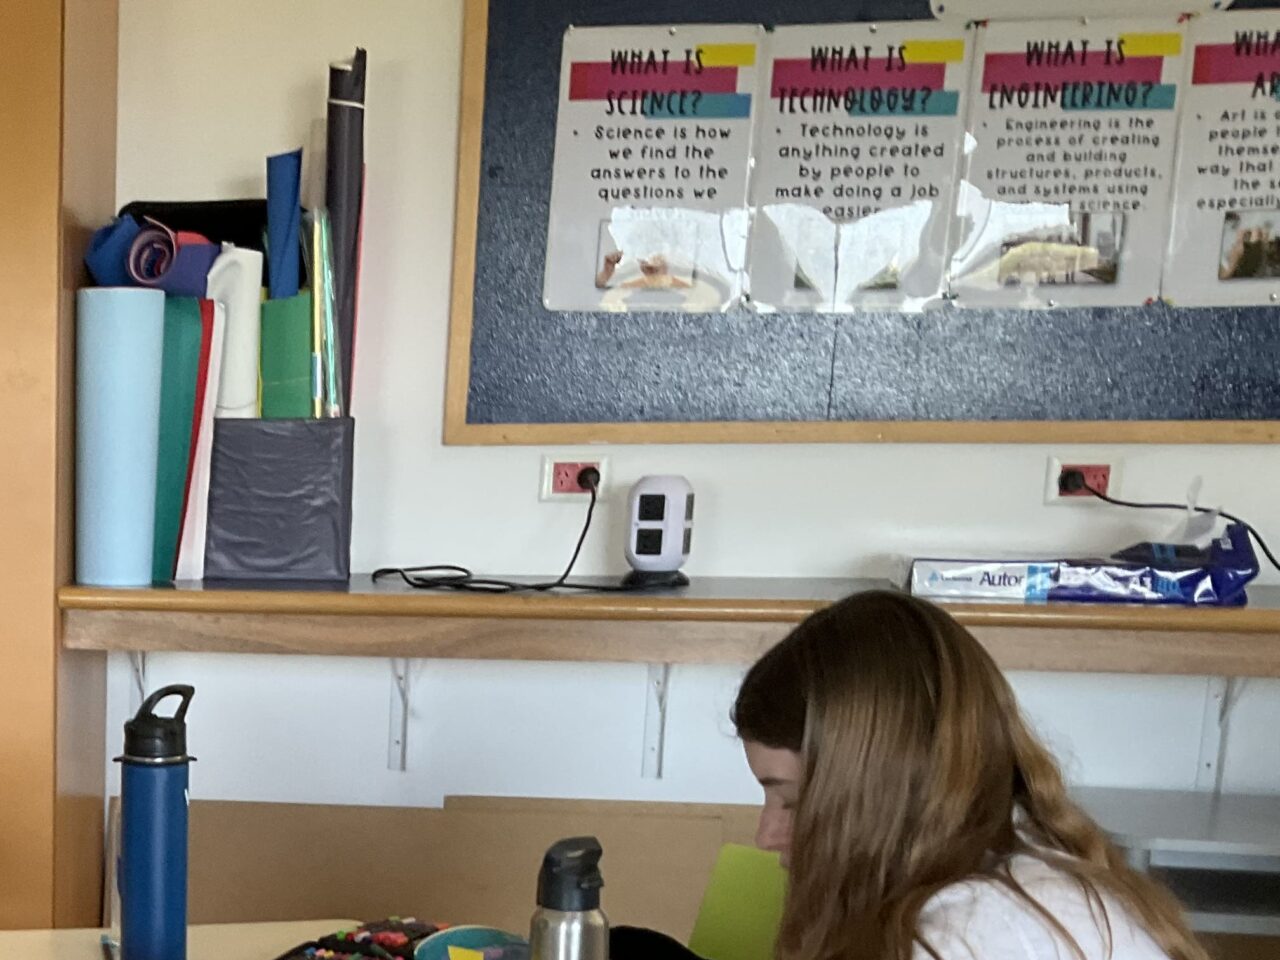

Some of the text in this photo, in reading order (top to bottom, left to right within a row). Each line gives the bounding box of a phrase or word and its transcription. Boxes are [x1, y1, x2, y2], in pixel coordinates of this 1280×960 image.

[810, 44, 908, 72] WHAT IS
[1026, 38, 1125, 67] WHAT IS
[610, 48, 704, 75] WHAT IS
[605, 89, 703, 116] SCIENCE?
[778, 86, 933, 114] TECHNOLOGY?
[988, 80, 1155, 110] ENGINEERING?
[1220, 109, 1246, 121] Art
[1253, 109, 1267, 121] is
[594, 125, 731, 140] Science is how
[800, 123, 929, 140] Technology is
[1005, 117, 1154, 133] Engineering is the
[996, 133, 1160, 149] process of creating
[1208, 126, 1268, 142] people
[608, 145, 715, 160] we find the
[778, 143, 945, 160] anything created
[1026, 150, 1127, 163] and building
[590, 164, 729, 180] answers to the
[798, 163, 920, 180] by people to
[1197, 160, 1273, 176] way that
[775, 183, 940, 200] make doing a job
[997, 183, 1149, 197] and systems using
[1233, 178, 1261, 191] the
[598, 185, 717, 203] questions we
